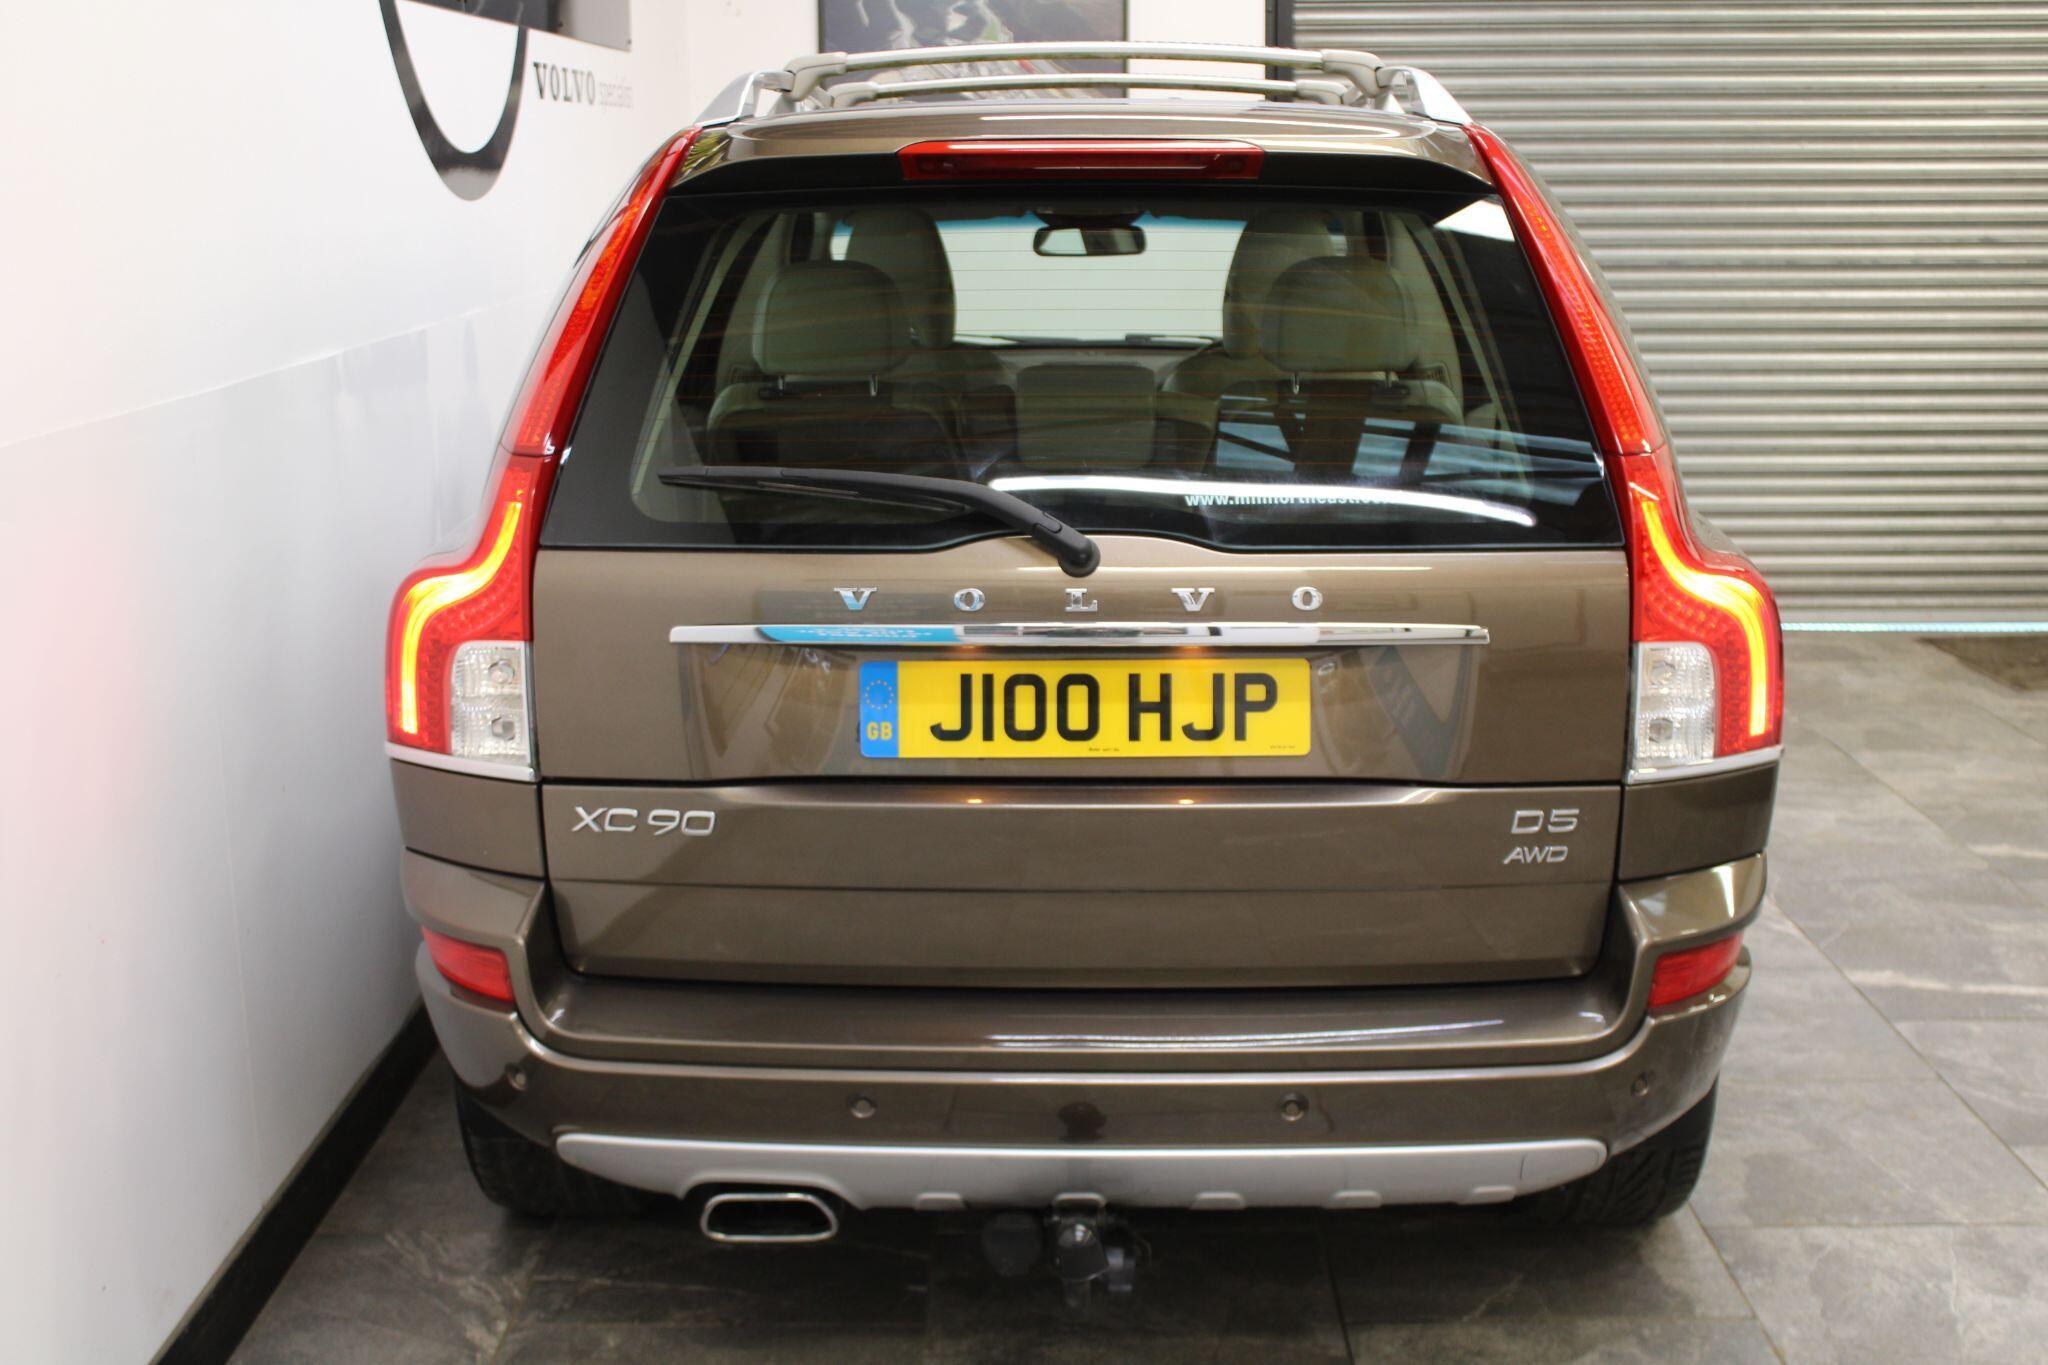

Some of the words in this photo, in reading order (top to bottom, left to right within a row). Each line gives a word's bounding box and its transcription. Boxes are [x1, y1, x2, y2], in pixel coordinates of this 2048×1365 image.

[532, 61, 596, 105] VOLVO
[833, 586, 1324, 612] VOLVO
[1128, 672, 1279, 742] HJP
[866, 721, 893, 741] GB
[1510, 808, 1580, 834] D5
[1503, 845, 1569, 865] AWD
